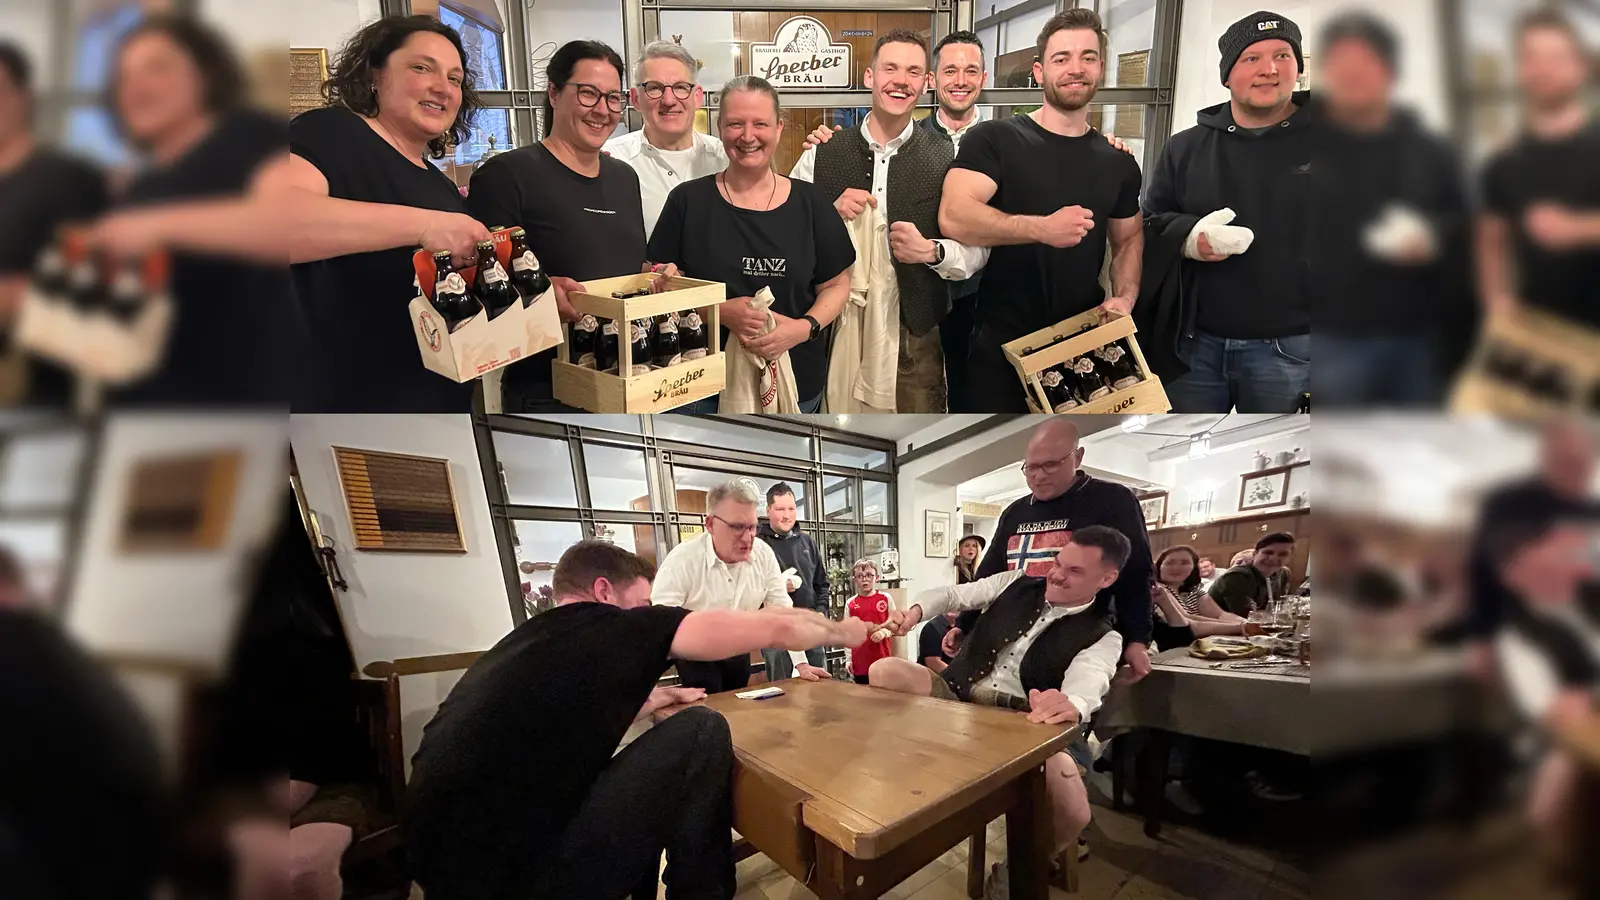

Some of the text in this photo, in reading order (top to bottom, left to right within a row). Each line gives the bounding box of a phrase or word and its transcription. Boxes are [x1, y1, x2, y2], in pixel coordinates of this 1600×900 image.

[1257, 20, 1280, 31] CAT
[760, 54, 842, 80] Sperber
[783, 73, 823, 83] BRÄU
[742, 256, 786, 272] TANZ
[652, 368, 705, 402] Sperber
[670, 387, 689, 398] BRÄU
